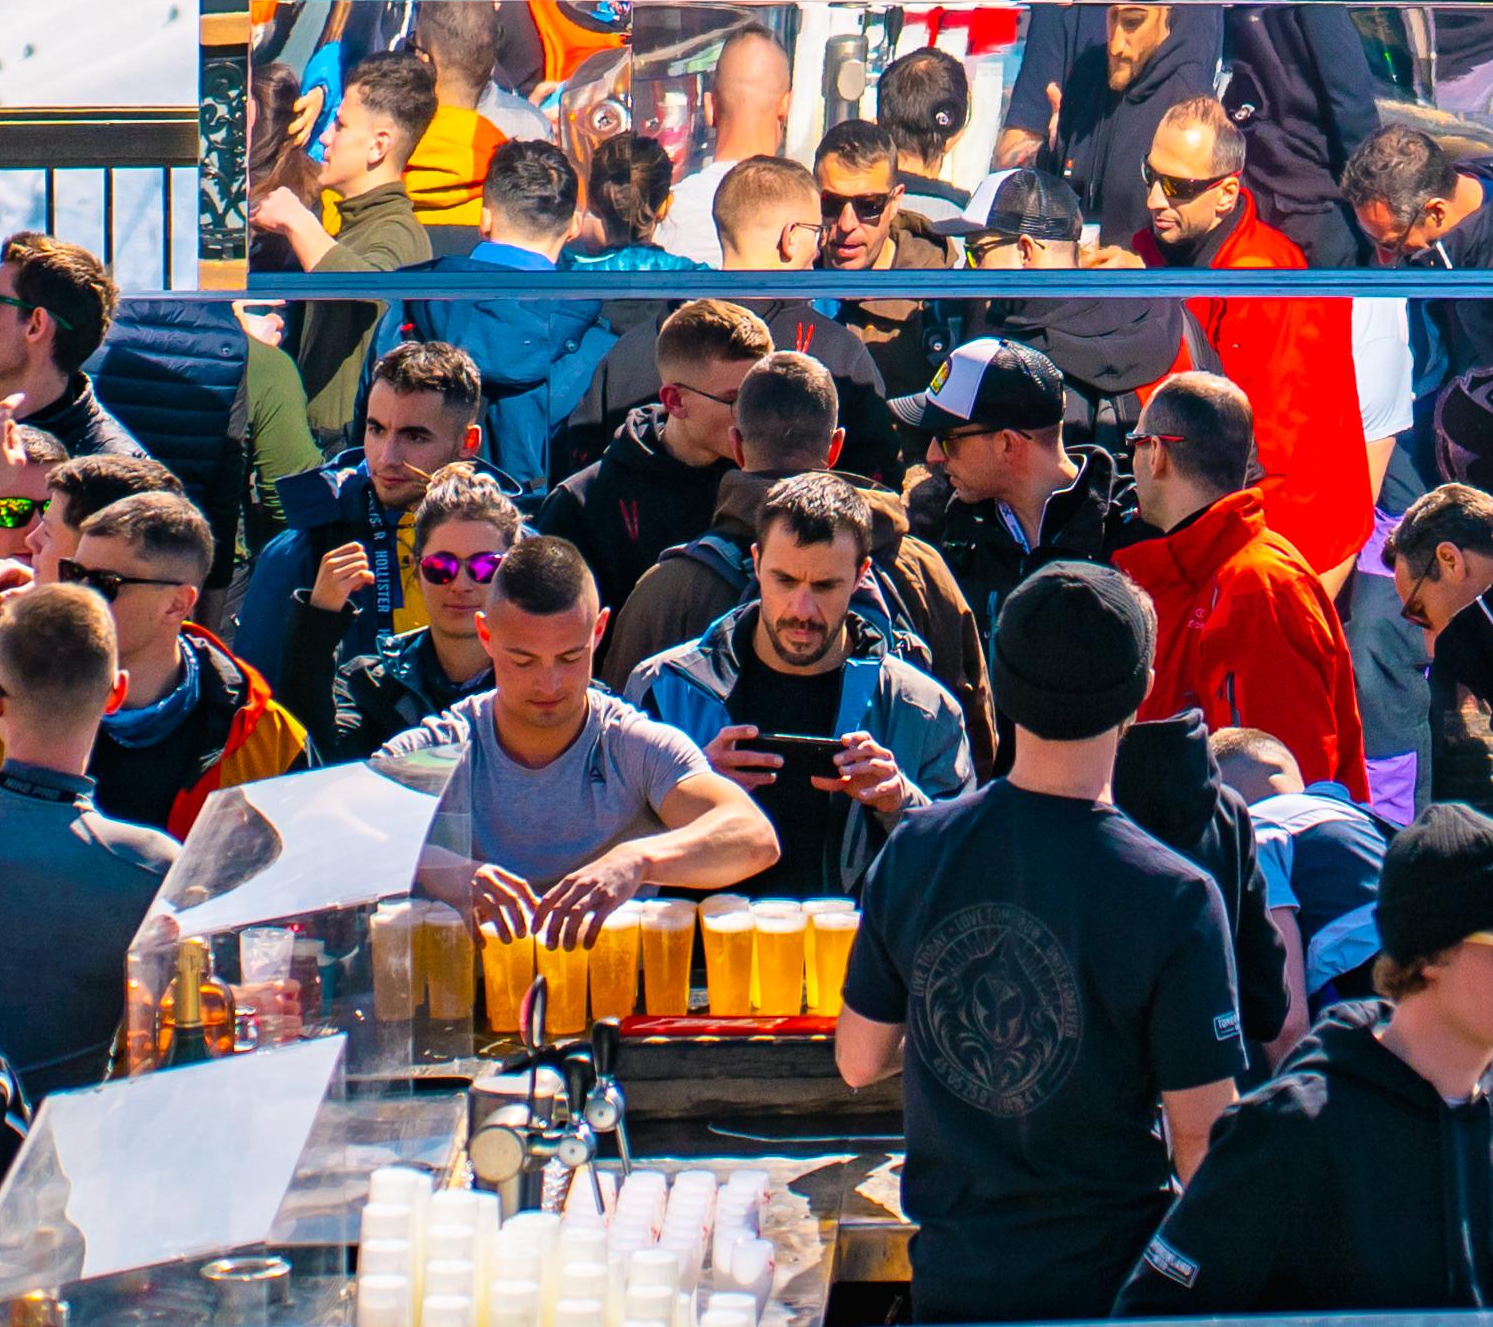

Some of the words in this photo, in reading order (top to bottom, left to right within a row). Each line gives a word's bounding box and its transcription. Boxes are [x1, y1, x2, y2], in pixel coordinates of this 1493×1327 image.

[374, 550, 391, 613] HOLLISTER
[3, 776, 33, 794] NIKE
[32, 784, 62, 801] PRO
[953, 910, 985, 931] LOVE
[987, 905, 1043, 940] TOMROW
[917, 932, 949, 969] TODAY
[910, 969, 928, 998] LIVE
